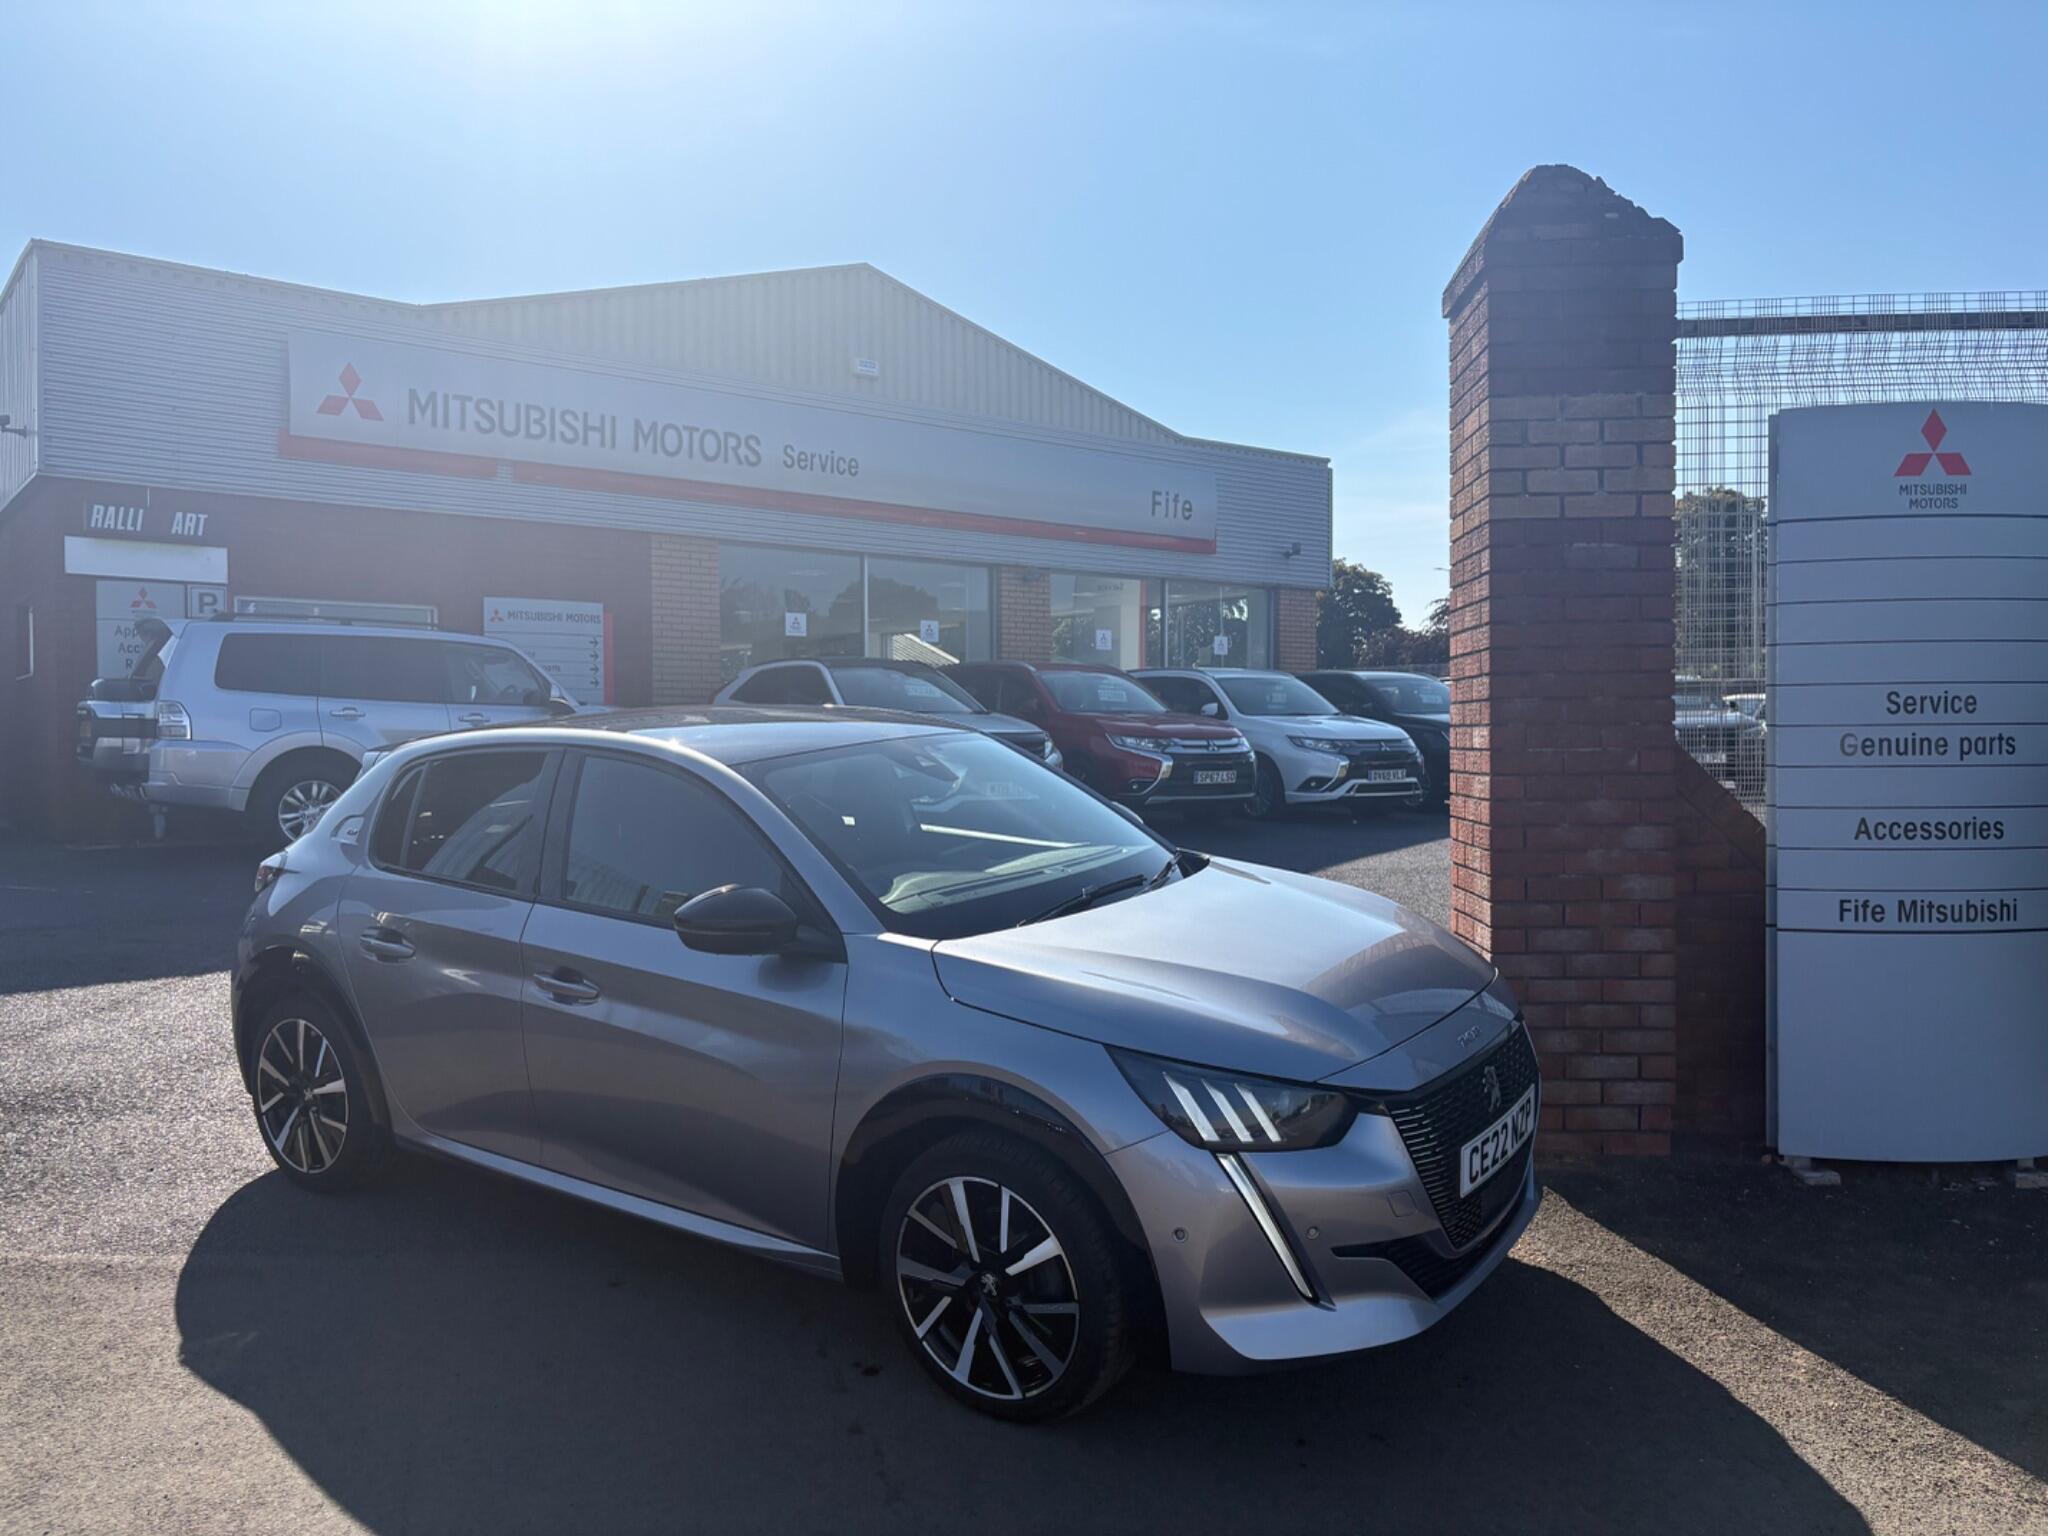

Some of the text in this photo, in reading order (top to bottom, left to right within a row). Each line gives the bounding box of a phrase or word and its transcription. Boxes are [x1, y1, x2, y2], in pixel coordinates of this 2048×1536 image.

[407, 387, 860, 478] MITSUBISHI MOTORS Service
[1899, 482, 1968, 496] MITSUBISHI
[1151, 490, 1193, 520] Fife
[1909, 497, 1959, 510] MOTORS
[90, 504, 208, 537] RALLI ART
[198, 592, 218, 614] P
[565, 613, 602, 625] MOTORS
[1886, 690, 1978, 715] Service
[1839, 732, 2016, 762] Genuine parts
[1854, 816, 2005, 842] Accessories
[1839, 898, 2018, 924] Fife Mitsubishi
[1468, 1122, 1509, 1185] CE22
